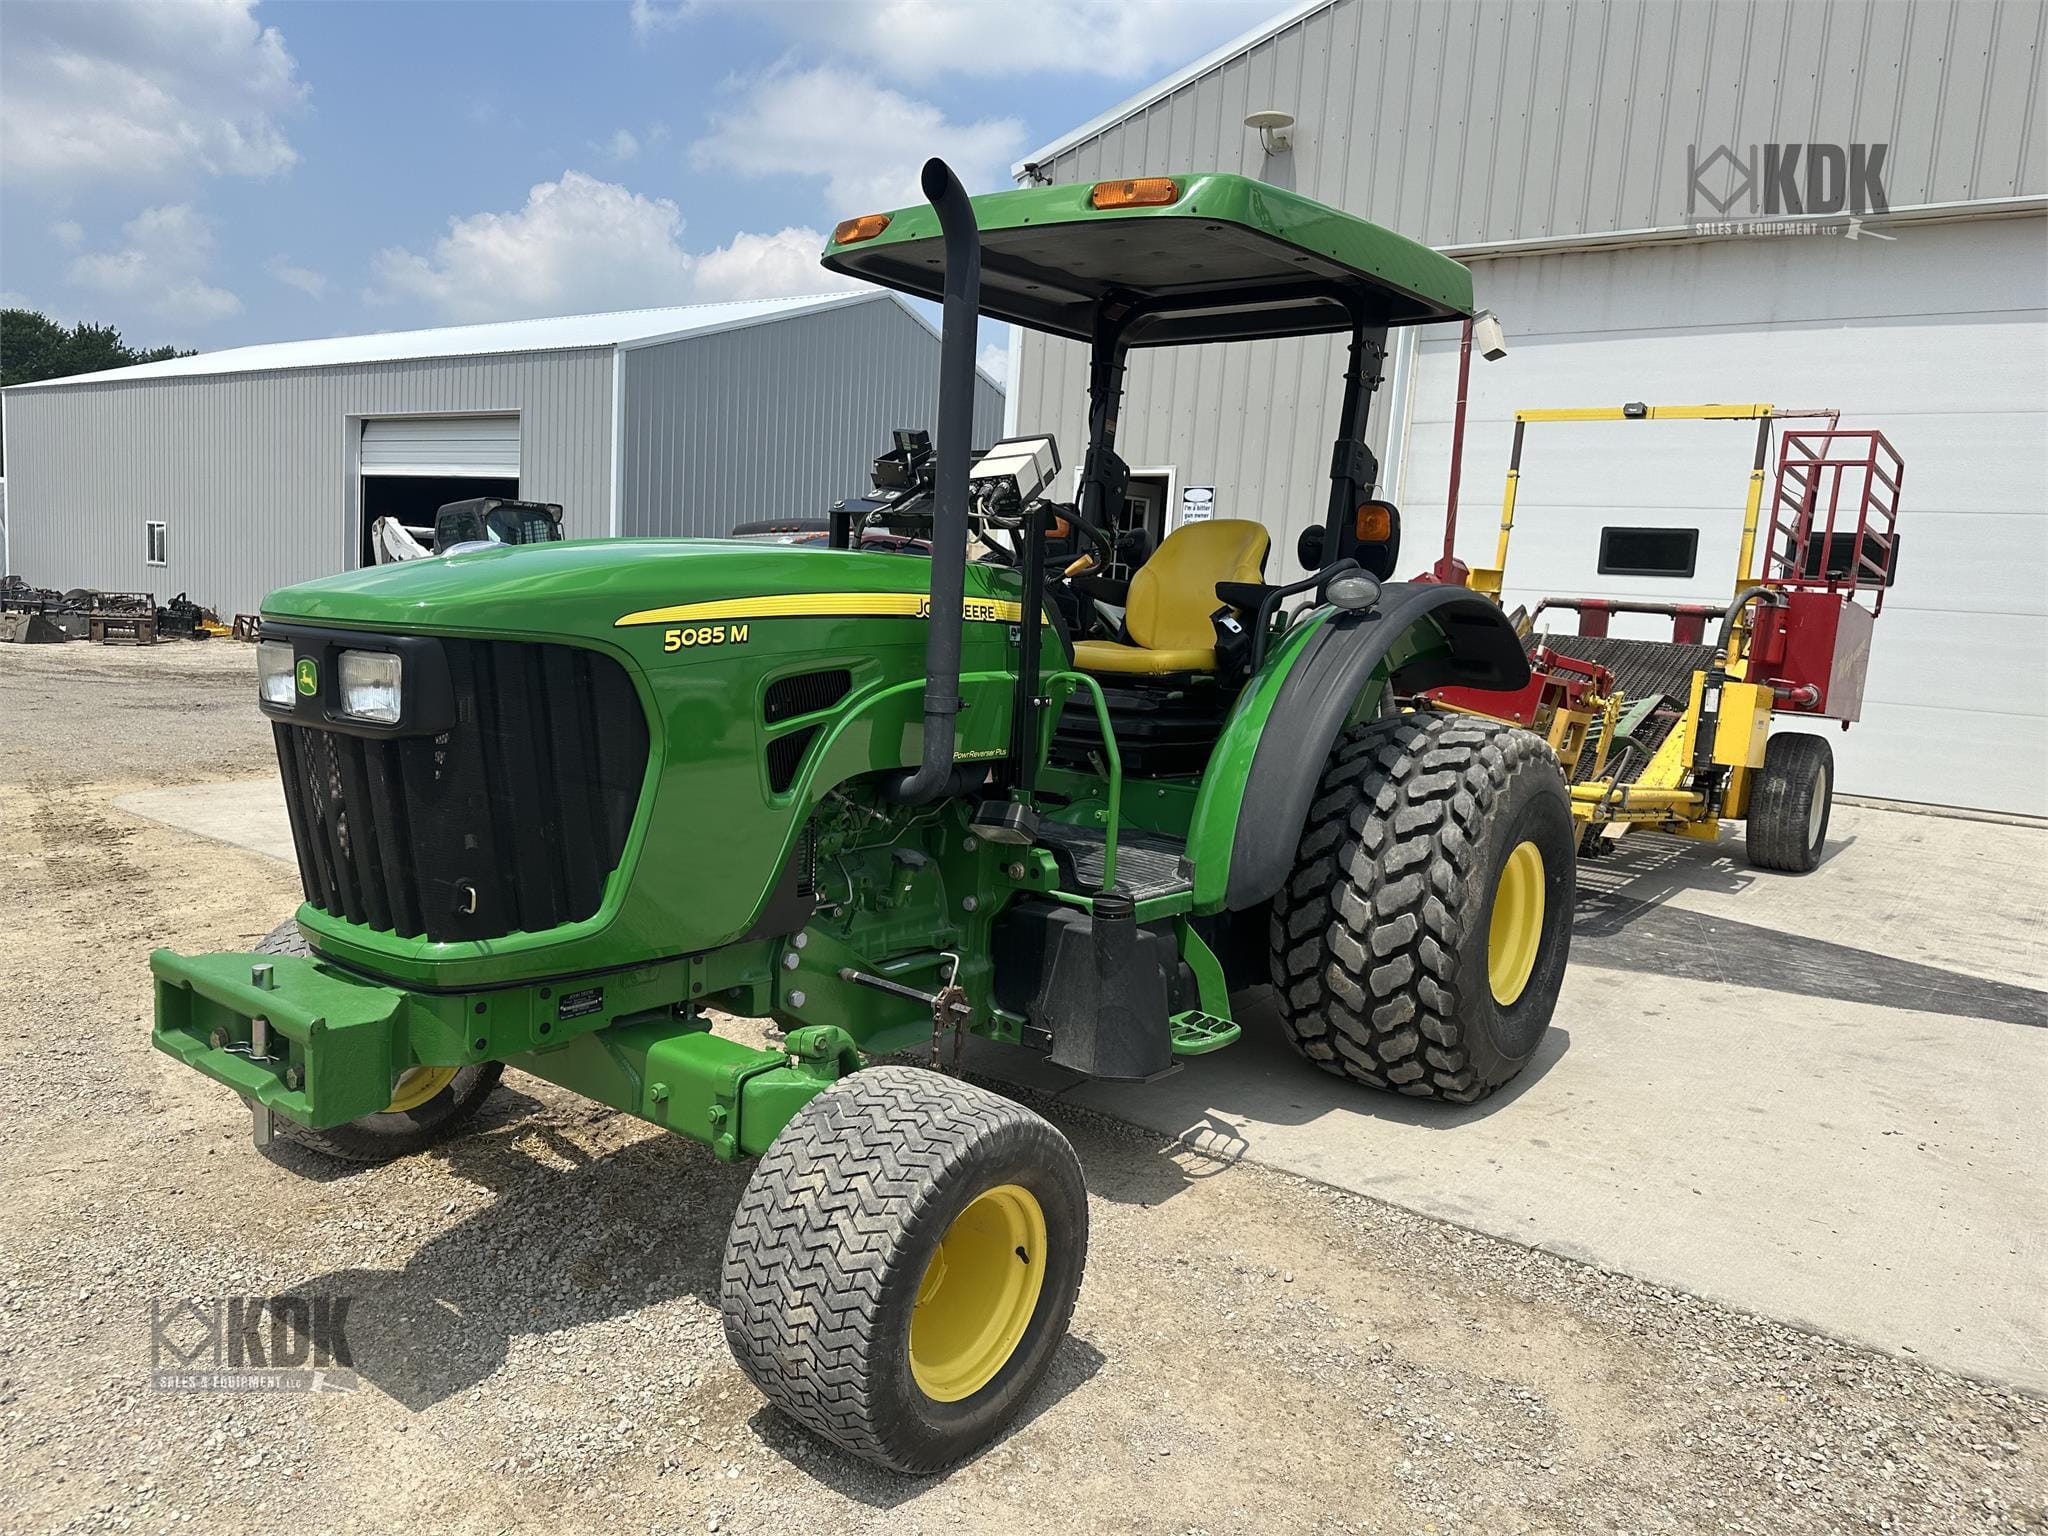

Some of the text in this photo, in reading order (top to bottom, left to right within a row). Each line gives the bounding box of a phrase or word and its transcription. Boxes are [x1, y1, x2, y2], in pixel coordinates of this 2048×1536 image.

[963, 604, 995, 619] EERE
[663, 623, 749, 653] 5085 M
[995, 748, 1007, 756] Plus
